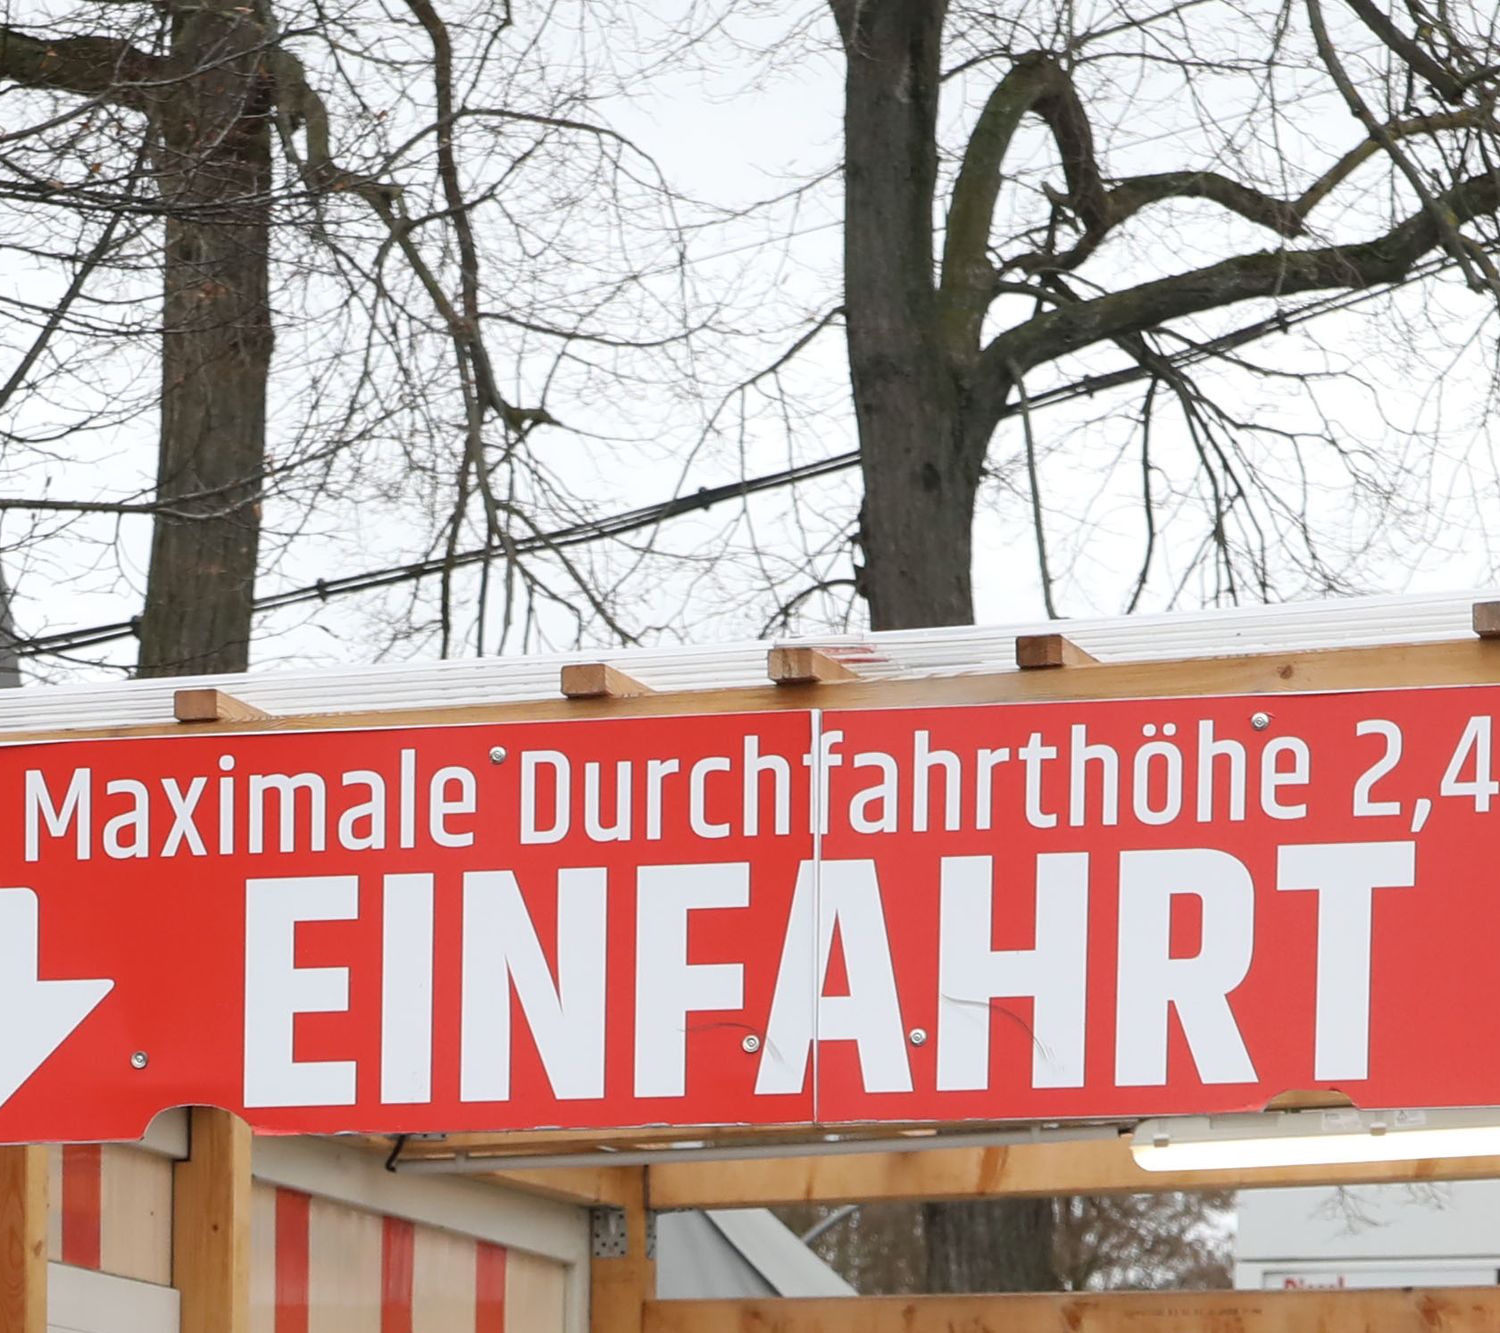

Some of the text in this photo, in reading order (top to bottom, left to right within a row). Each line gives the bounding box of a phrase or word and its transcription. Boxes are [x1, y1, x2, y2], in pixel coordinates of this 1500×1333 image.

[24, 748, 477, 863] Maximale
[519, 718, 1310, 846] Durchfahrthöhe
[243, 840, 1416, 1109] EINFAHRT
